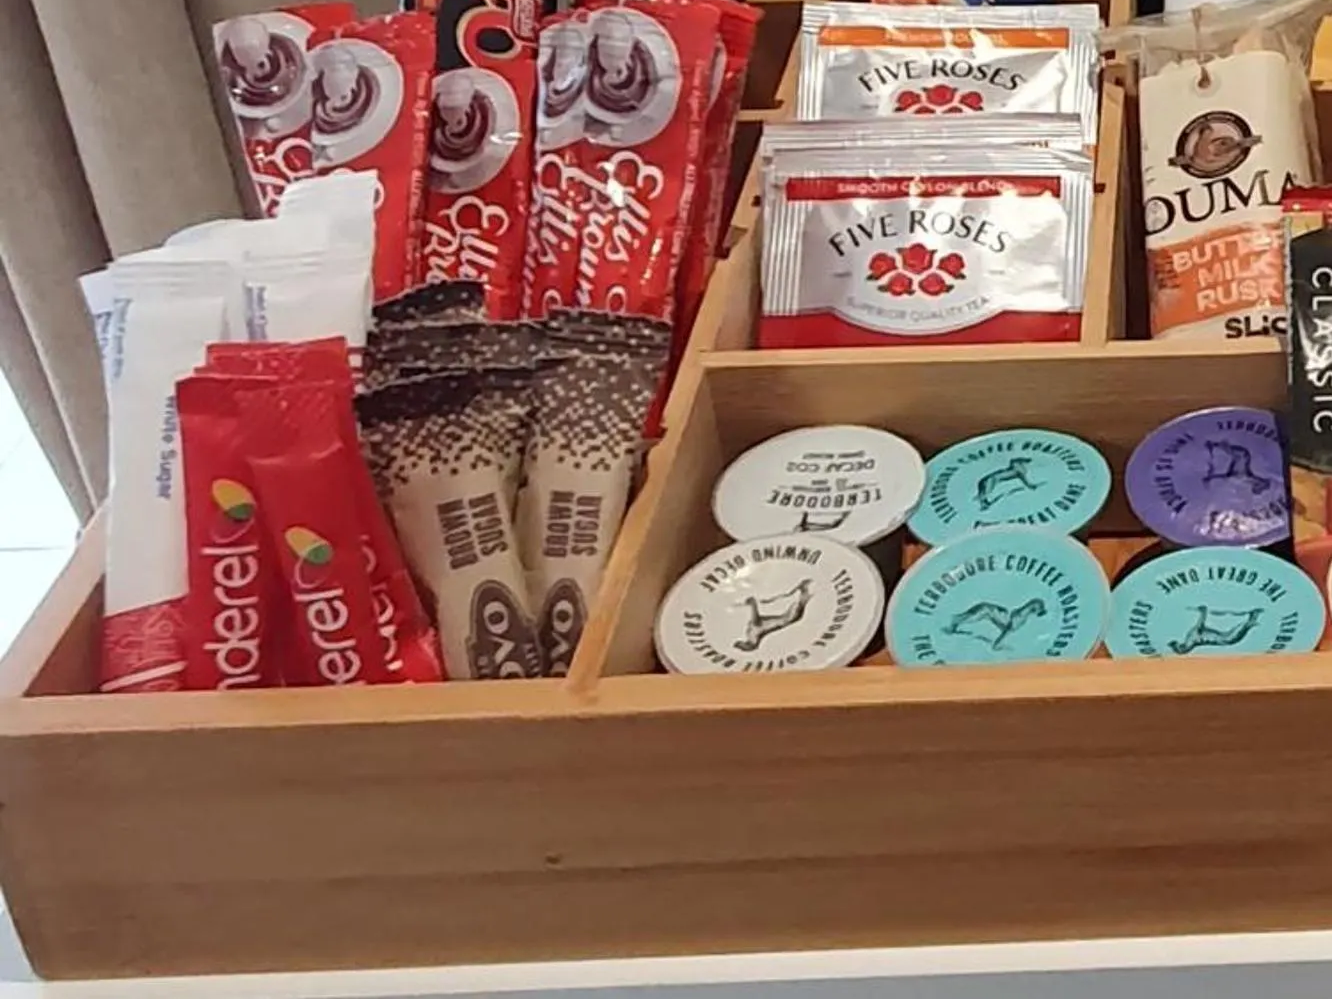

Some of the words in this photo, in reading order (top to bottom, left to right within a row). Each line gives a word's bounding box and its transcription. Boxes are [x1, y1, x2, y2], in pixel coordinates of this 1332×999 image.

[858, 59, 921, 92] FIVE
[930, 59, 1026, 91] ROSES
[837, 182, 898, 194] SMOOTH
[828, 212, 897, 257] FIVE
[909, 209, 1014, 253] ROSES
[1199, 257, 1278, 287] MILK
[847, 297, 907, 320] SUPERIOR
[910, 304, 965, 323] QUALITY
[965, 296, 991, 312] TEA
[1196, 279, 1283, 312] RUSK
[825, 458, 875, 474] DECAF
[768, 488, 882, 509] TERBODORE
[437, 499, 478, 570] BROWN
[468, 492, 509, 558] SUGAR
[543, 491, 576, 559] BROWN
[572, 495, 603, 558] SUGAR
[751, 546, 822, 567] UNWIND
[1005, 554, 1065, 587] COFFEE
[700, 556, 746, 594] DECAF
[1156, 568, 1201, 595] DANE
[1207, 566, 1258, 587] GREAT
[1258, 577, 1289, 603] THE
[912, 633, 937, 661] THE
